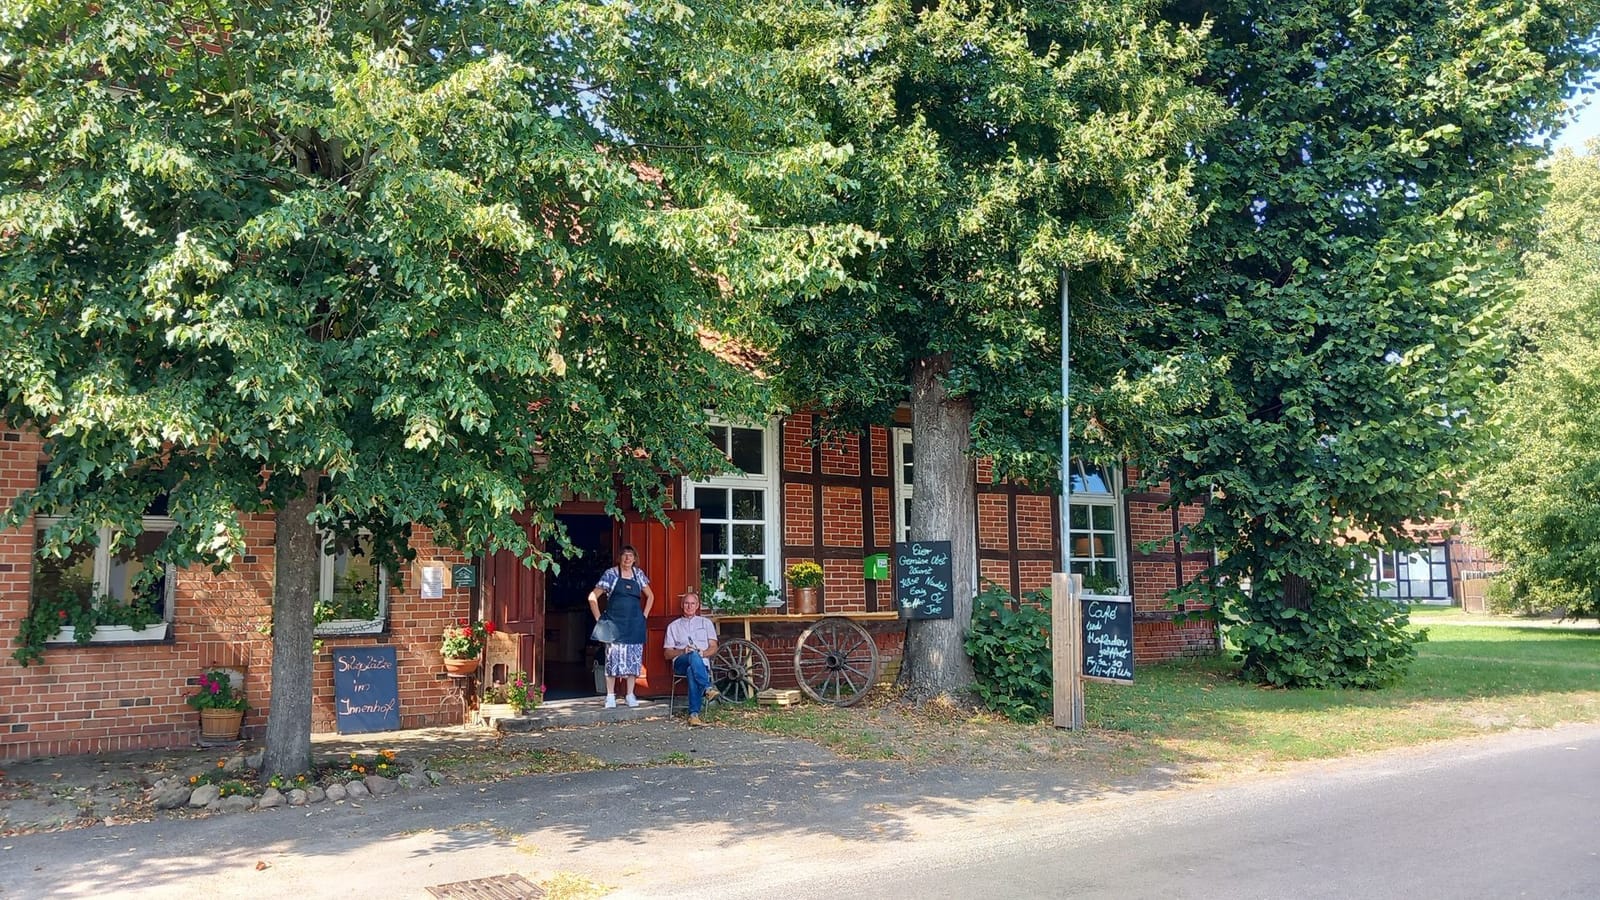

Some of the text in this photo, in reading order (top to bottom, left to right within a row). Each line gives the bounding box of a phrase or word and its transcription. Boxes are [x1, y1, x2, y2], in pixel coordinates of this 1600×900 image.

[899, 555, 928, 566] Gemüse
[930, 553, 948, 566] Obst
[1088, 601, 1118, 624] Café
[353, 679, 371, 692] im
[338, 697, 396, 720] Innenhof
